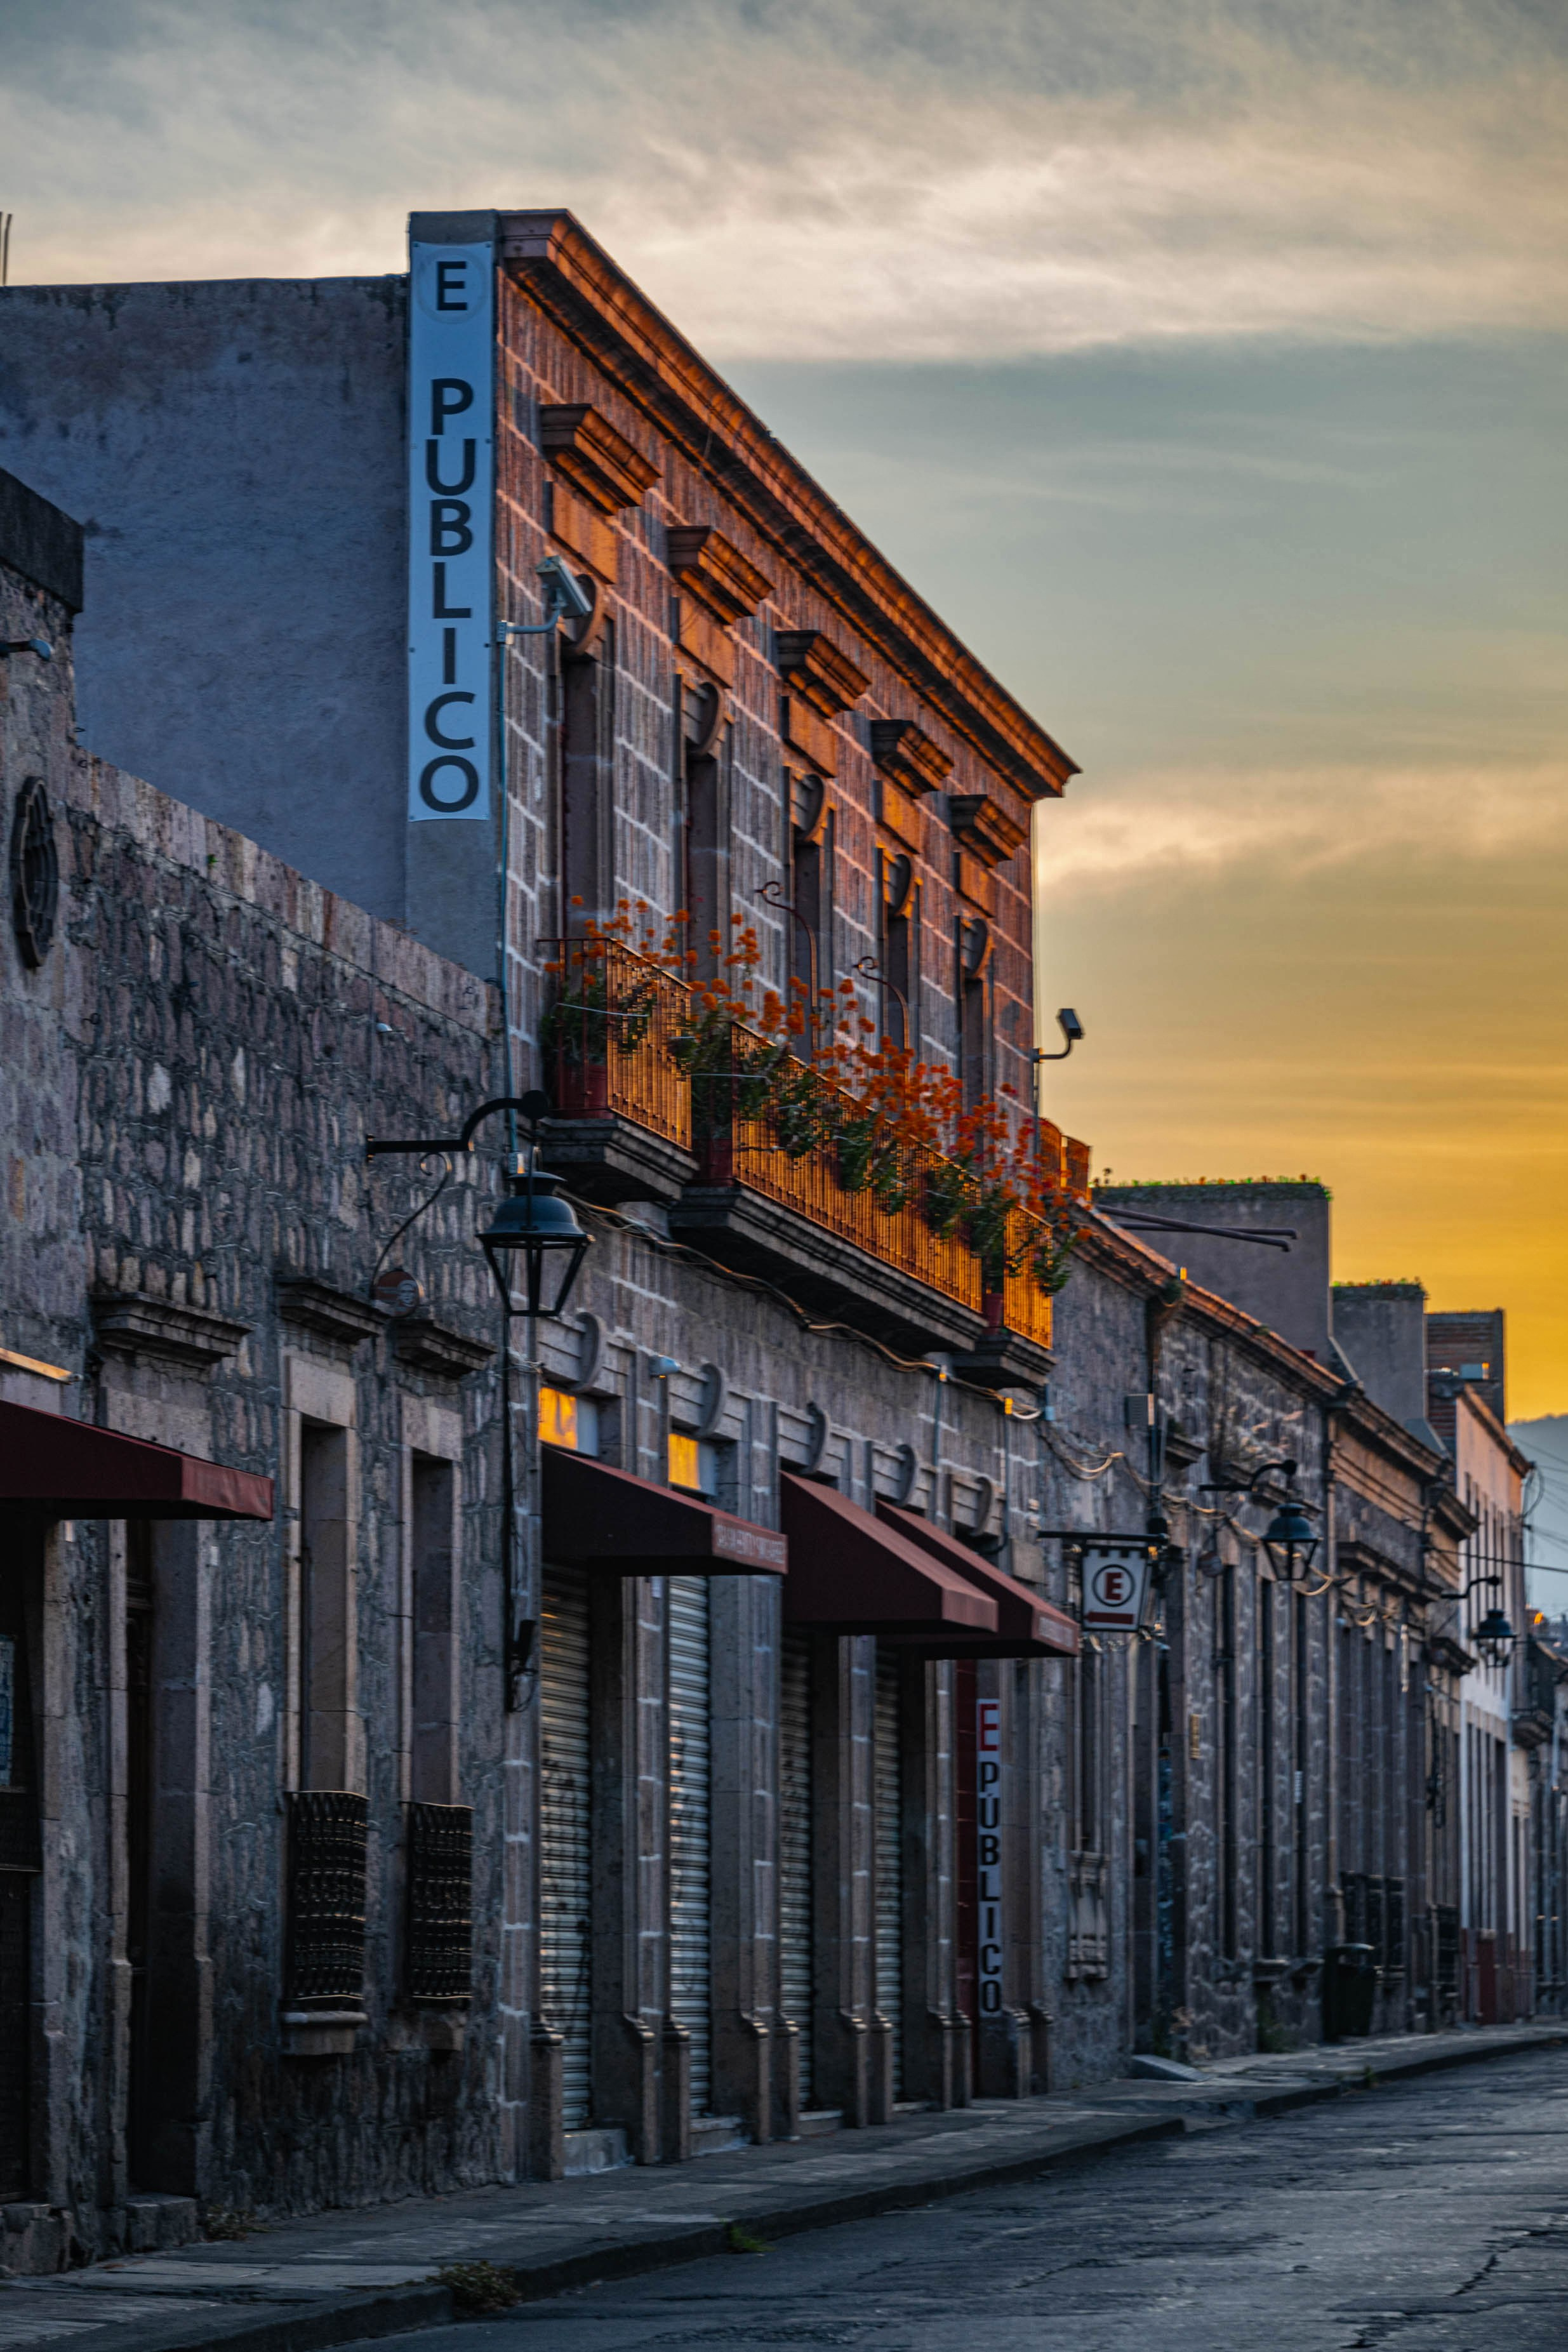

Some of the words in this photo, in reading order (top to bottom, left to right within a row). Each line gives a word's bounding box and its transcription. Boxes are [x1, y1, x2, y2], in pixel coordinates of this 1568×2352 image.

[435, 261, 468, 310] E
[419, 378, 479, 813] PUBLICO
[1105, 1572, 1123, 1600] E
[980, 1704, 999, 1751] E
